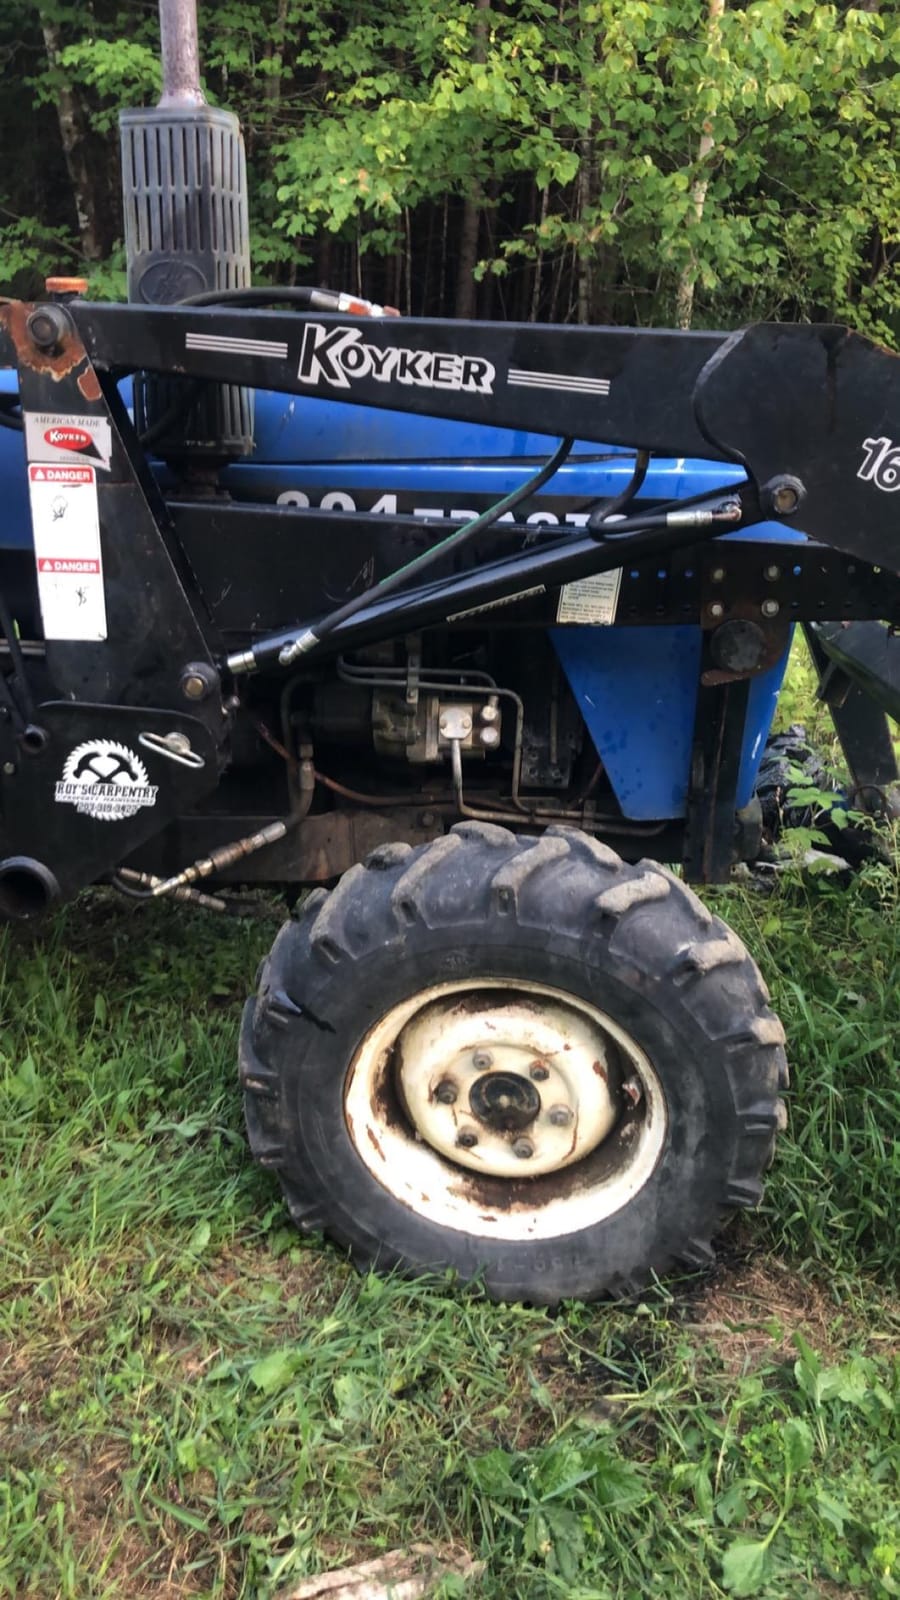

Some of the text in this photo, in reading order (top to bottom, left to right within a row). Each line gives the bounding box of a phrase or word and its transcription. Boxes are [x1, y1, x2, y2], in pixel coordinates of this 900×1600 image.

[298, 323, 496, 394] KOYKER
[47, 470, 90, 481] DANGER
[54, 562, 97, 572] DANGER
